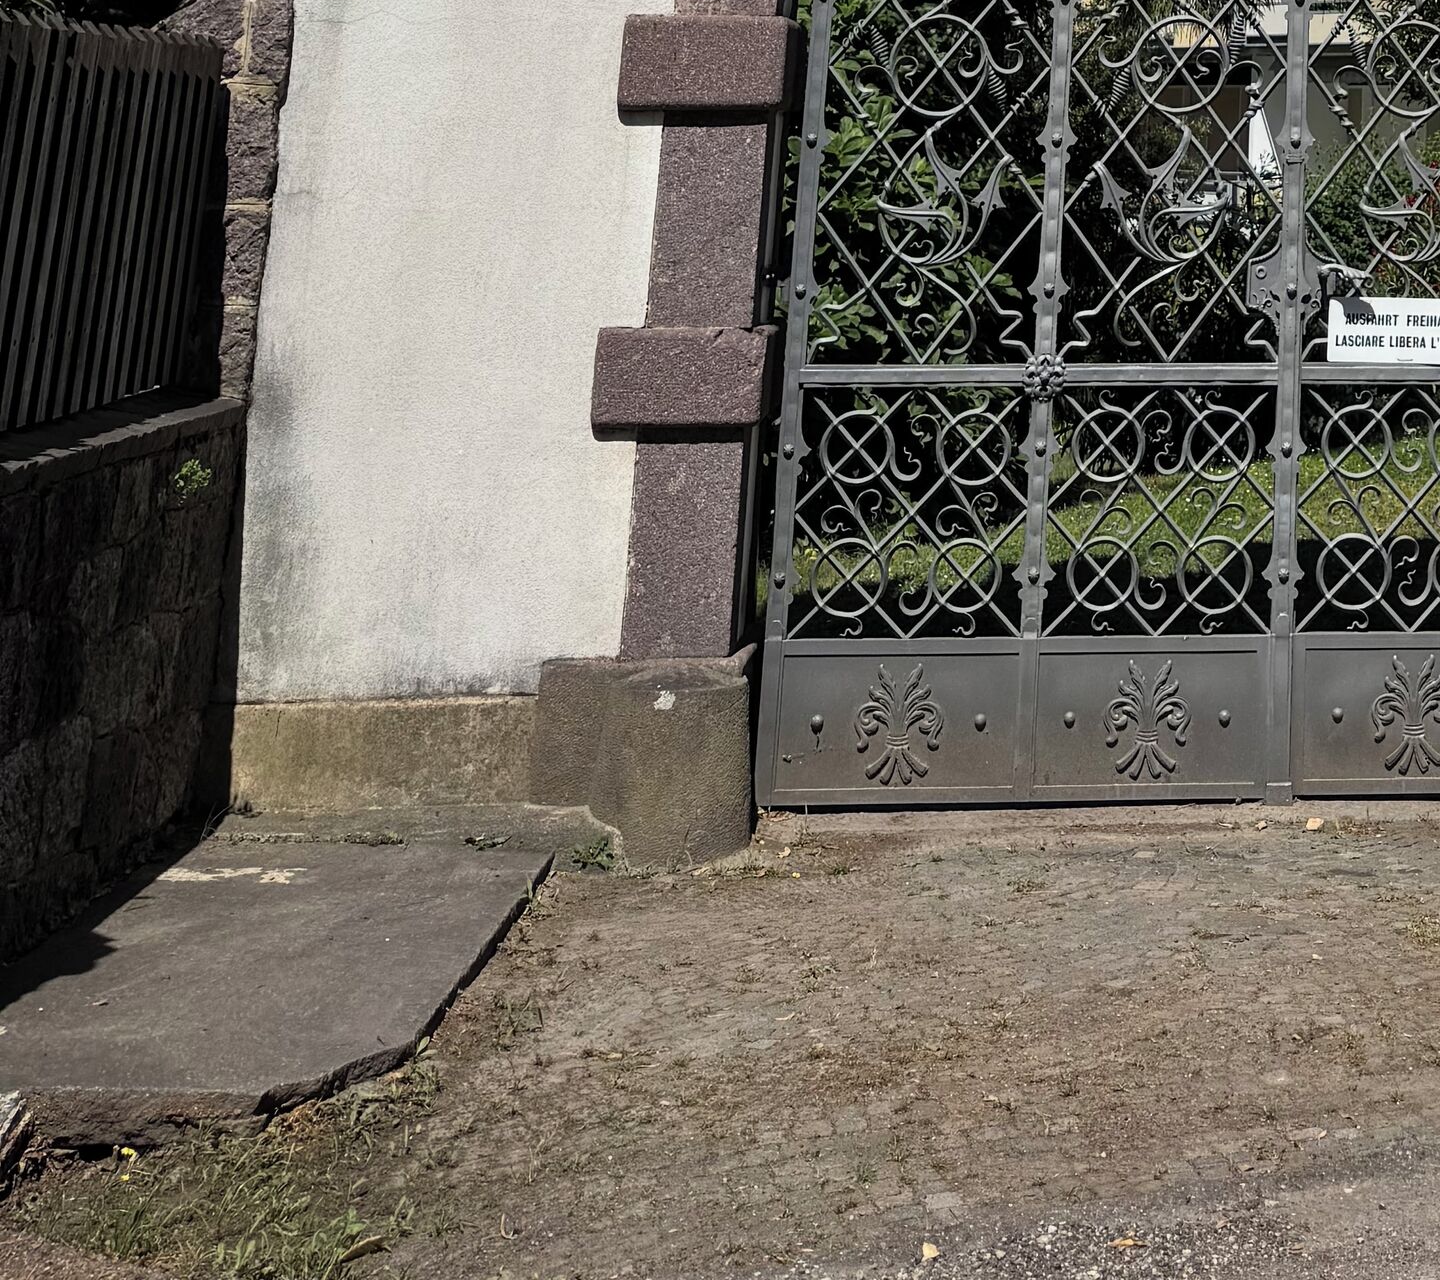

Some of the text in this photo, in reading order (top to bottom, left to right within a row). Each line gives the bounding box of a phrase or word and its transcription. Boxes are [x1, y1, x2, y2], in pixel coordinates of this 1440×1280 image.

[1345, 313, 1399, 326] AUSFAHRT
[1335, 335, 1384, 347] LASCIARE
[1389, 336, 1426, 349] LIBERA
